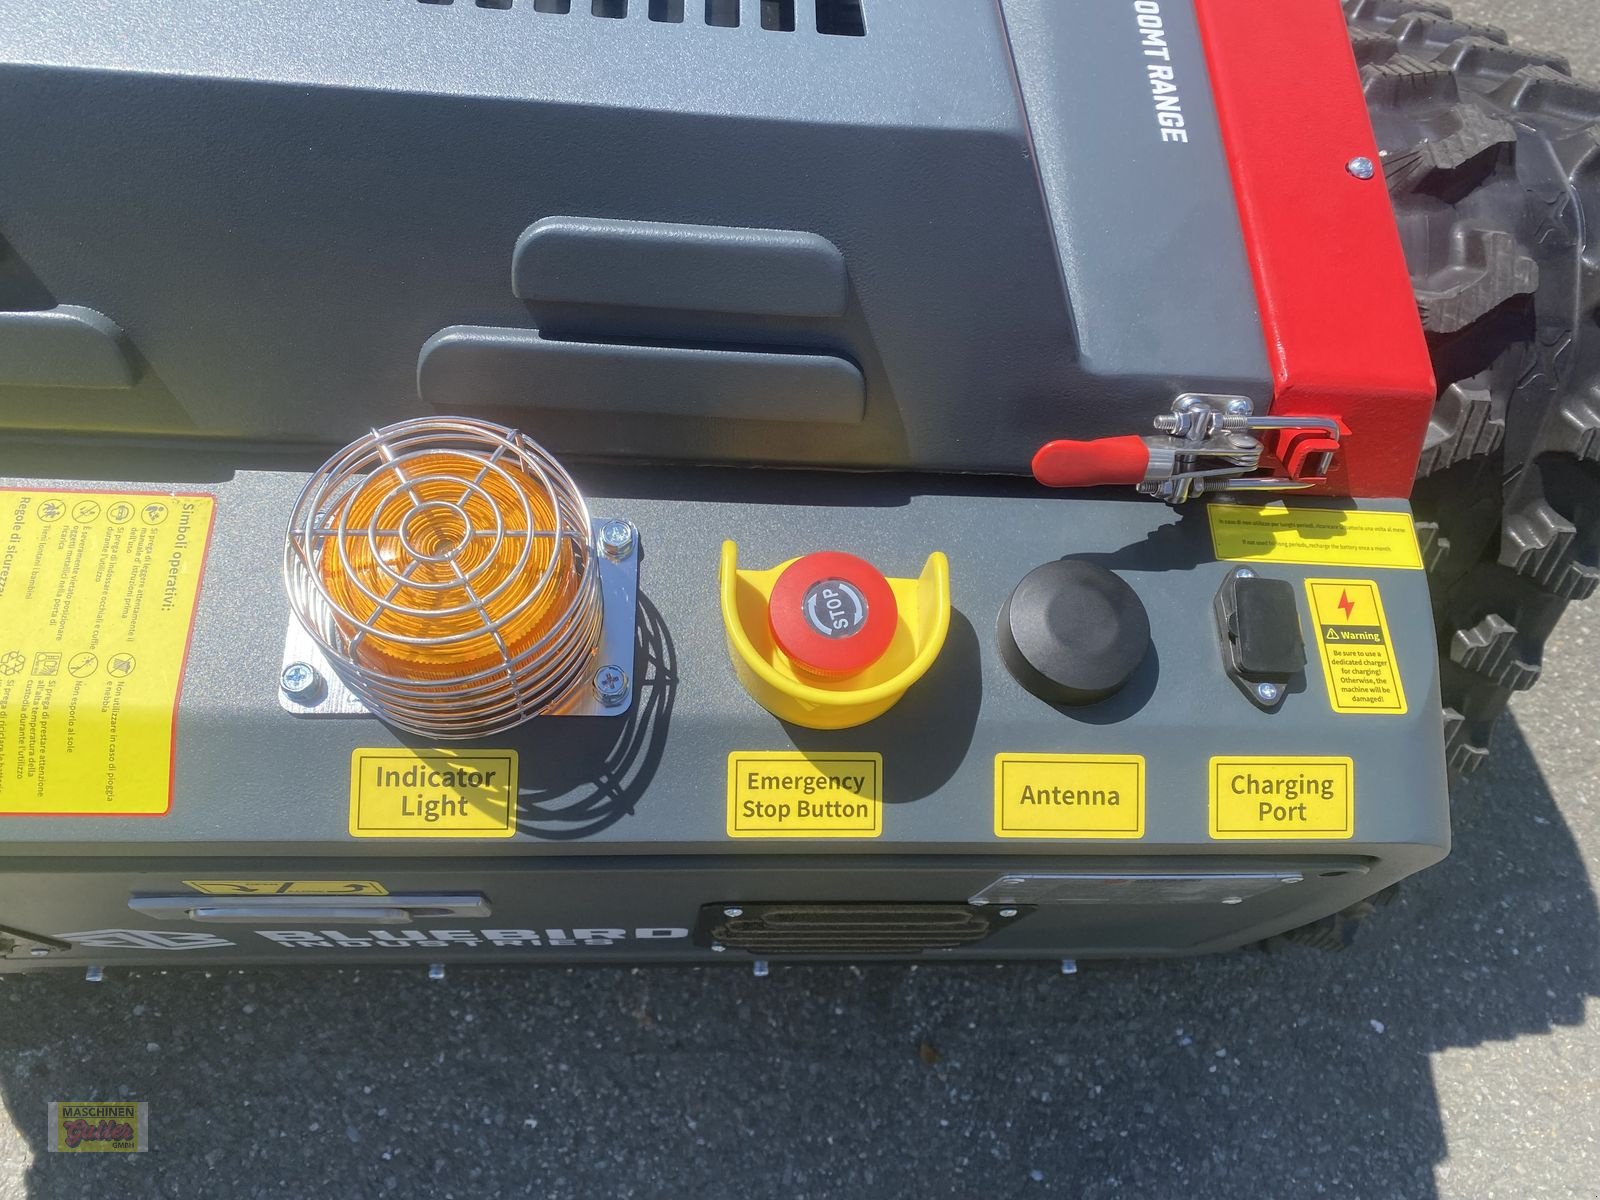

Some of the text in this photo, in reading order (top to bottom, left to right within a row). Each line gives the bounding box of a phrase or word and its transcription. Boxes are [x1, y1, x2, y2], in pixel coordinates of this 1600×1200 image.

[1147, 65, 1188, 143] RANGE
[13, 497, 31, 530] Regole
[10, 533, 21, 542] di
[41, 525, 51, 541] Tieni
[58, 526, 70, 549] ricarica
[68, 526, 79, 549] oggetti
[111, 535, 122, 552] prega
[126, 528, 138, 553] dell'uso
[135, 528, 147, 560] manuale
[144, 536, 156, 554] prega
[33, 543, 47, 565] lontani
[61, 550, 73, 579] metallici
[71, 532, 89, 574] severamente
[95, 527, 114, 582] durante l'utilizzo
[161, 504, 194, 611] Simboli operativi:
[25, 571, 39, 599] bambini
[66, 576, 77, 599] vietato
[102, 563, 117, 595] indossare
[126, 565, 140, 597] istruzioni
[139, 564, 151, 588] leggere
[56, 581, 66, 597] nella
[51, 599, 61, 617] porta
[96, 597, 109, 623] occhiali
[122, 598, 132, 618] prima
[128, 590, 146, 636] attentamente
[822, 588, 849, 630] STOP
[55, 601, 71, 641] posizionare
[89, 630, 102, 650] cuffie
[1341, 631, 1380, 642] Warning
[32, 680, 44, 705] all'alta
[72, 680, 82, 696] Non
[115, 682, 125, 696] Non
[1341, 677, 1375, 685] Otherwise,
[0, 688, 11, 710] prega
[42, 689, 52, 710] prega
[101, 687, 112, 712] nebbia
[68, 698, 79, 726] esporlo
[110, 698, 120, 733] utilizzare
[17, 680, 34, 779] custodia durante l'utilizzo
[28, 707, 39, 756] temperatura
[39, 721, 48, 753] prestare
[68, 728, 75, 736] al
[28, 758, 36, 777] della
[37, 755, 46, 797] attenzione
[375, 765, 497, 790] Indicator
[105, 773, 115, 802] pioggia
[747, 771, 865, 796] Emergency
[1020, 784, 1120, 806] Antenna
[1231, 773, 1334, 800] Charging
[400, 795, 468, 822] Light
[742, 799, 869, 821] Stop Button
[1258, 802, 1307, 821] Port
[254, 927, 689, 941] BLUEBIRD
[276, 938, 614, 948] INDUSTRIES
